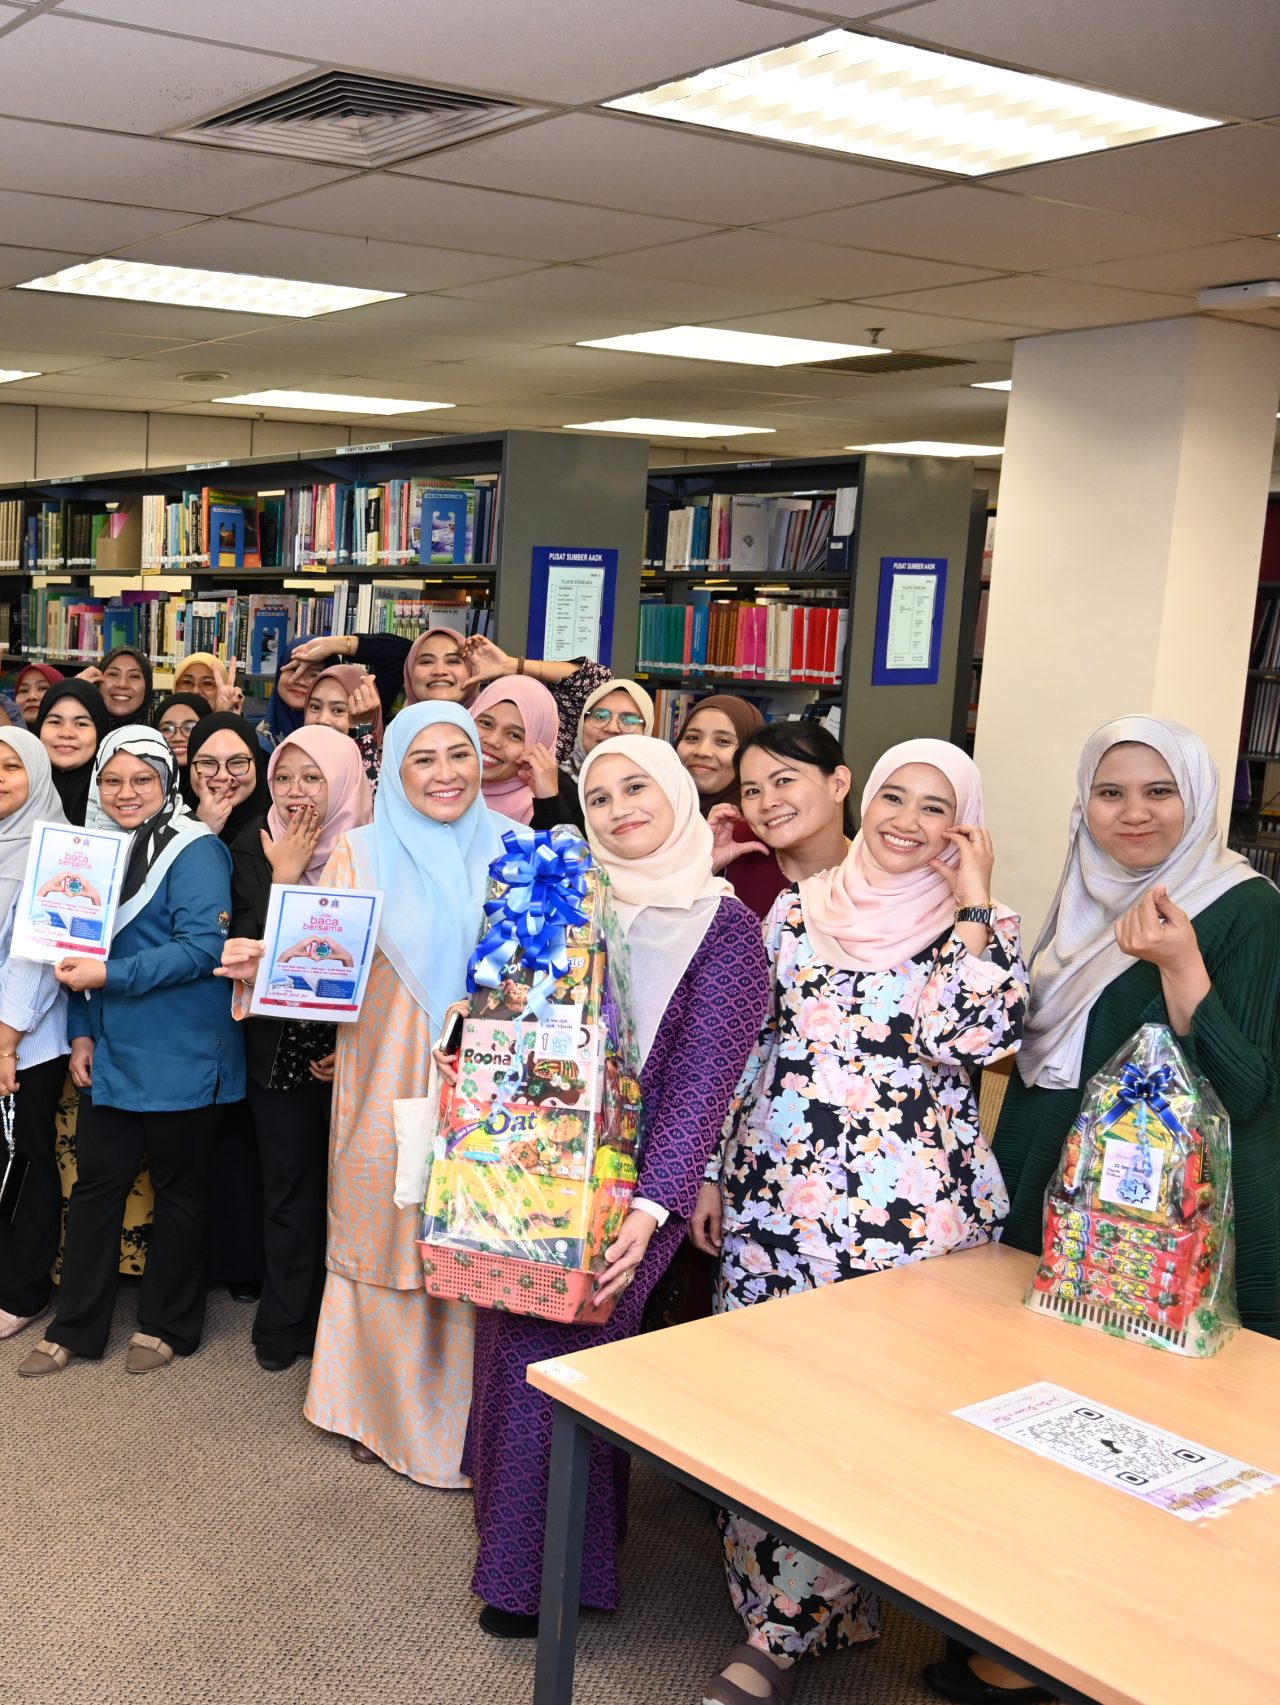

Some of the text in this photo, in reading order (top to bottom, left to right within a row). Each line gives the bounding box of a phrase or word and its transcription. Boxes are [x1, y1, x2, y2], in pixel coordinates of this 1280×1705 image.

[566, 553, 588, 561] SUMBER
[64, 852, 89, 863] baca
[58, 859, 92, 870] bersama
[310, 916, 339, 926] baca
[302, 923, 343, 932] bersama
[464, 1048, 512, 1066] Roona
[485, 1110, 538, 1135] Oat
